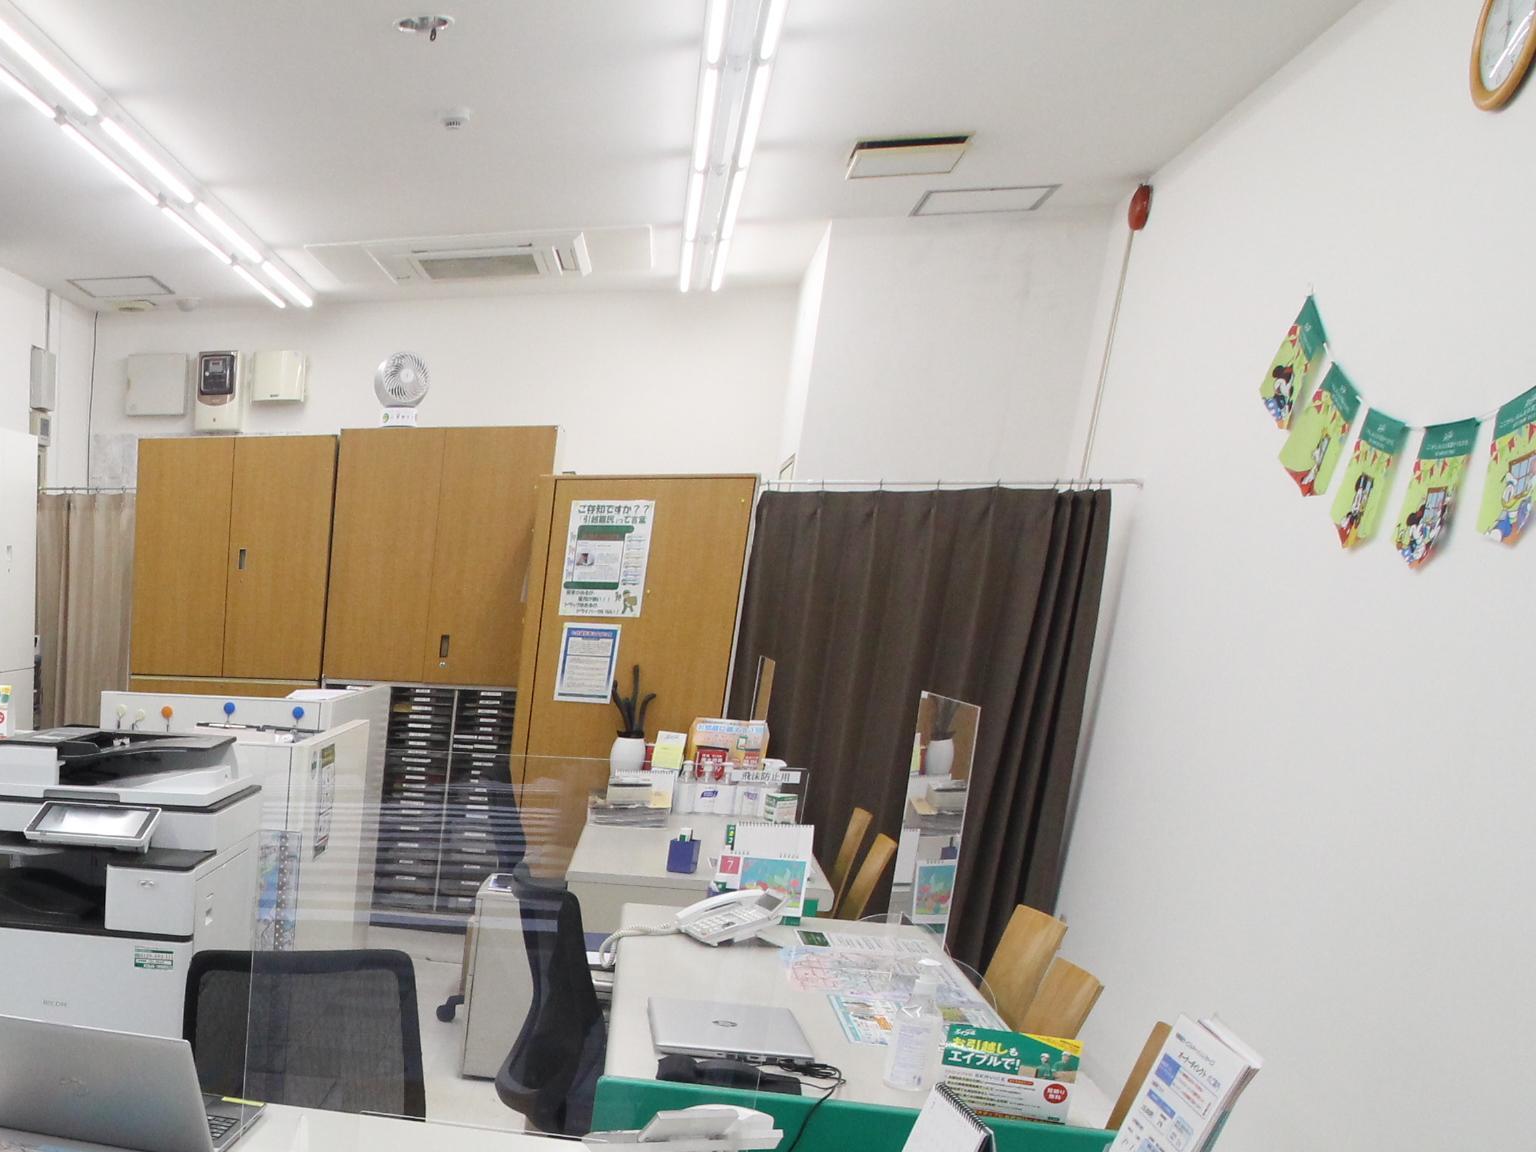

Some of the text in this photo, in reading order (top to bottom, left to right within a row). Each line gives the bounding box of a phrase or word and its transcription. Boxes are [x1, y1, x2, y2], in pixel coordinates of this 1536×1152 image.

[952, 1036, 1019, 1057] お引越しも
[948, 1050, 1021, 1071] エイブルで!
